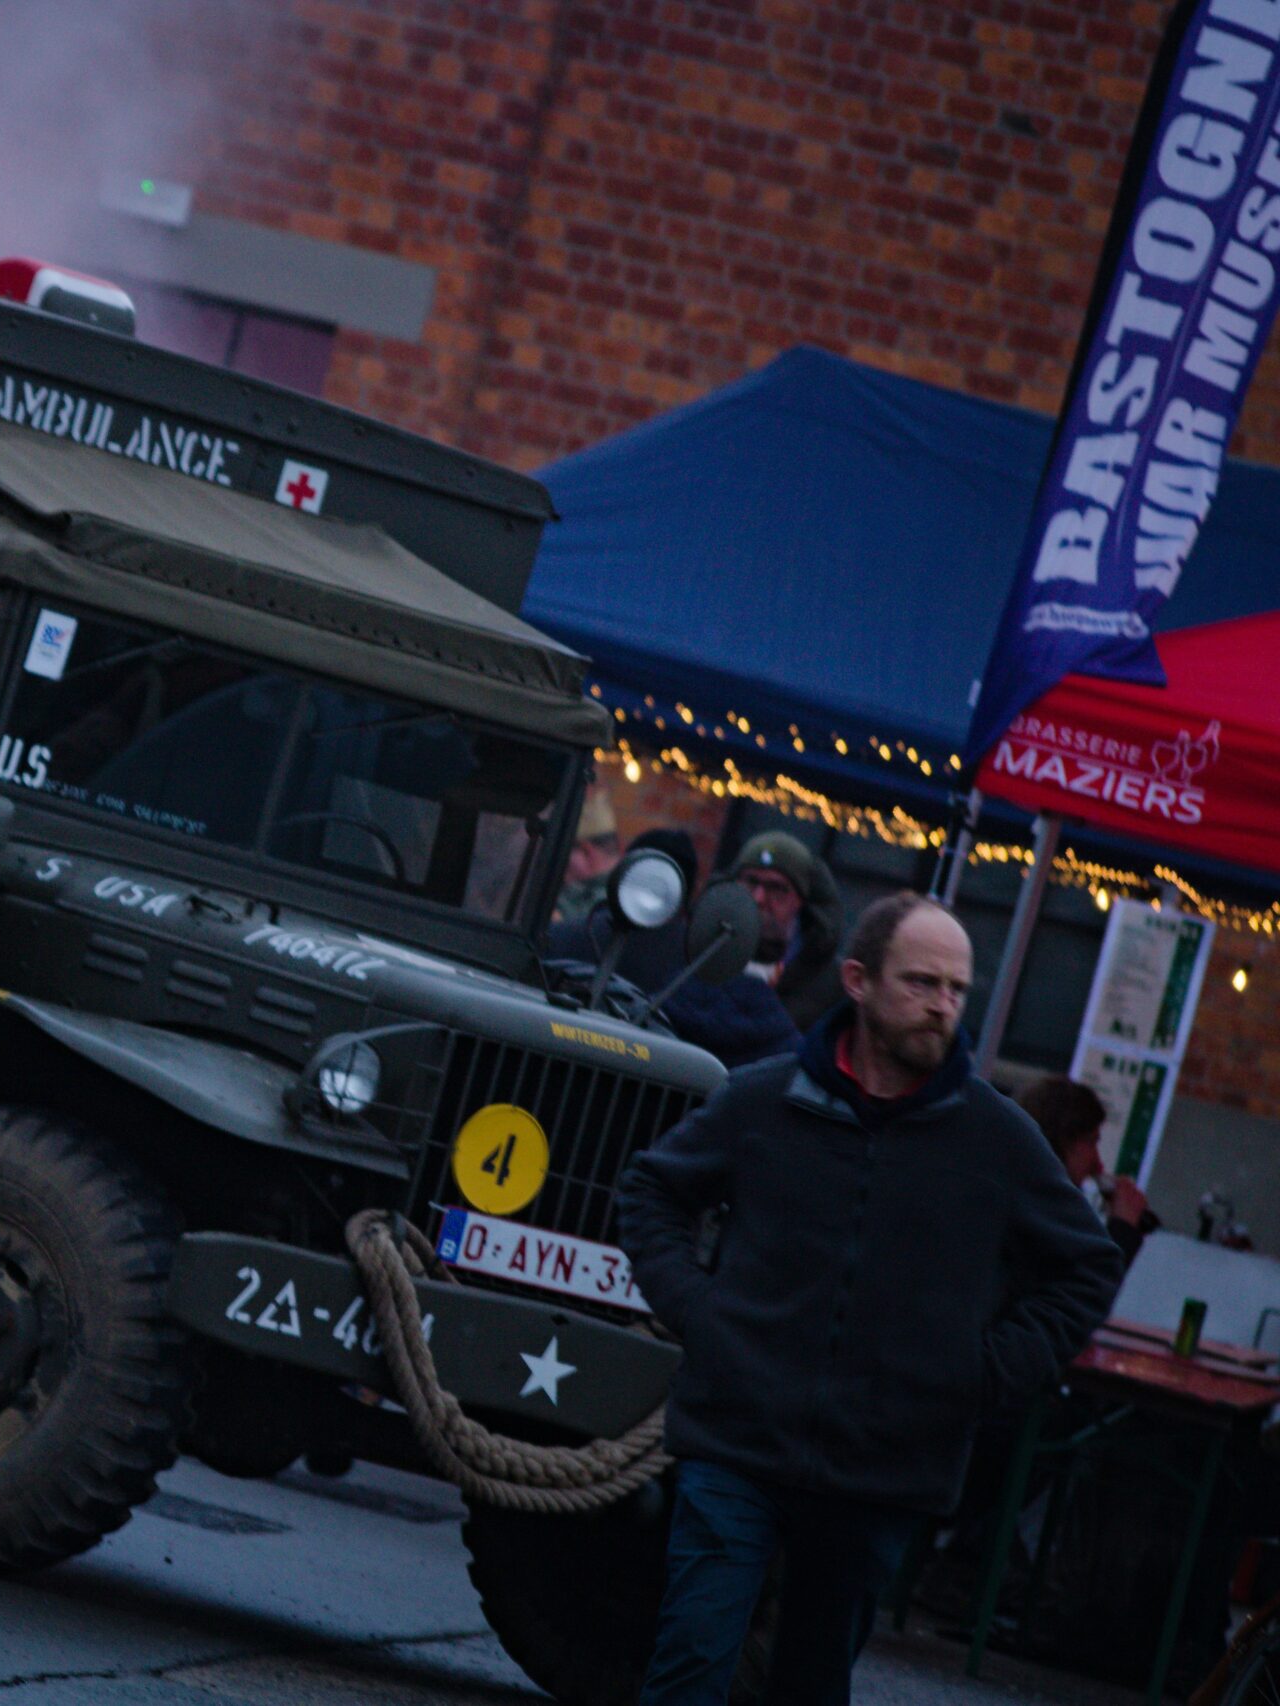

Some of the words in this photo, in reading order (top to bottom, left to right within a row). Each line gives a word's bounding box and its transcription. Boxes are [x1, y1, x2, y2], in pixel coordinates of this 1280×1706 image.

[1133, 397, 1227, 599] WAR
[992, 739, 1206, 825] MAZIERS
[93, 876, 181, 918] USA
[481, 1133, 516, 1187] 4
